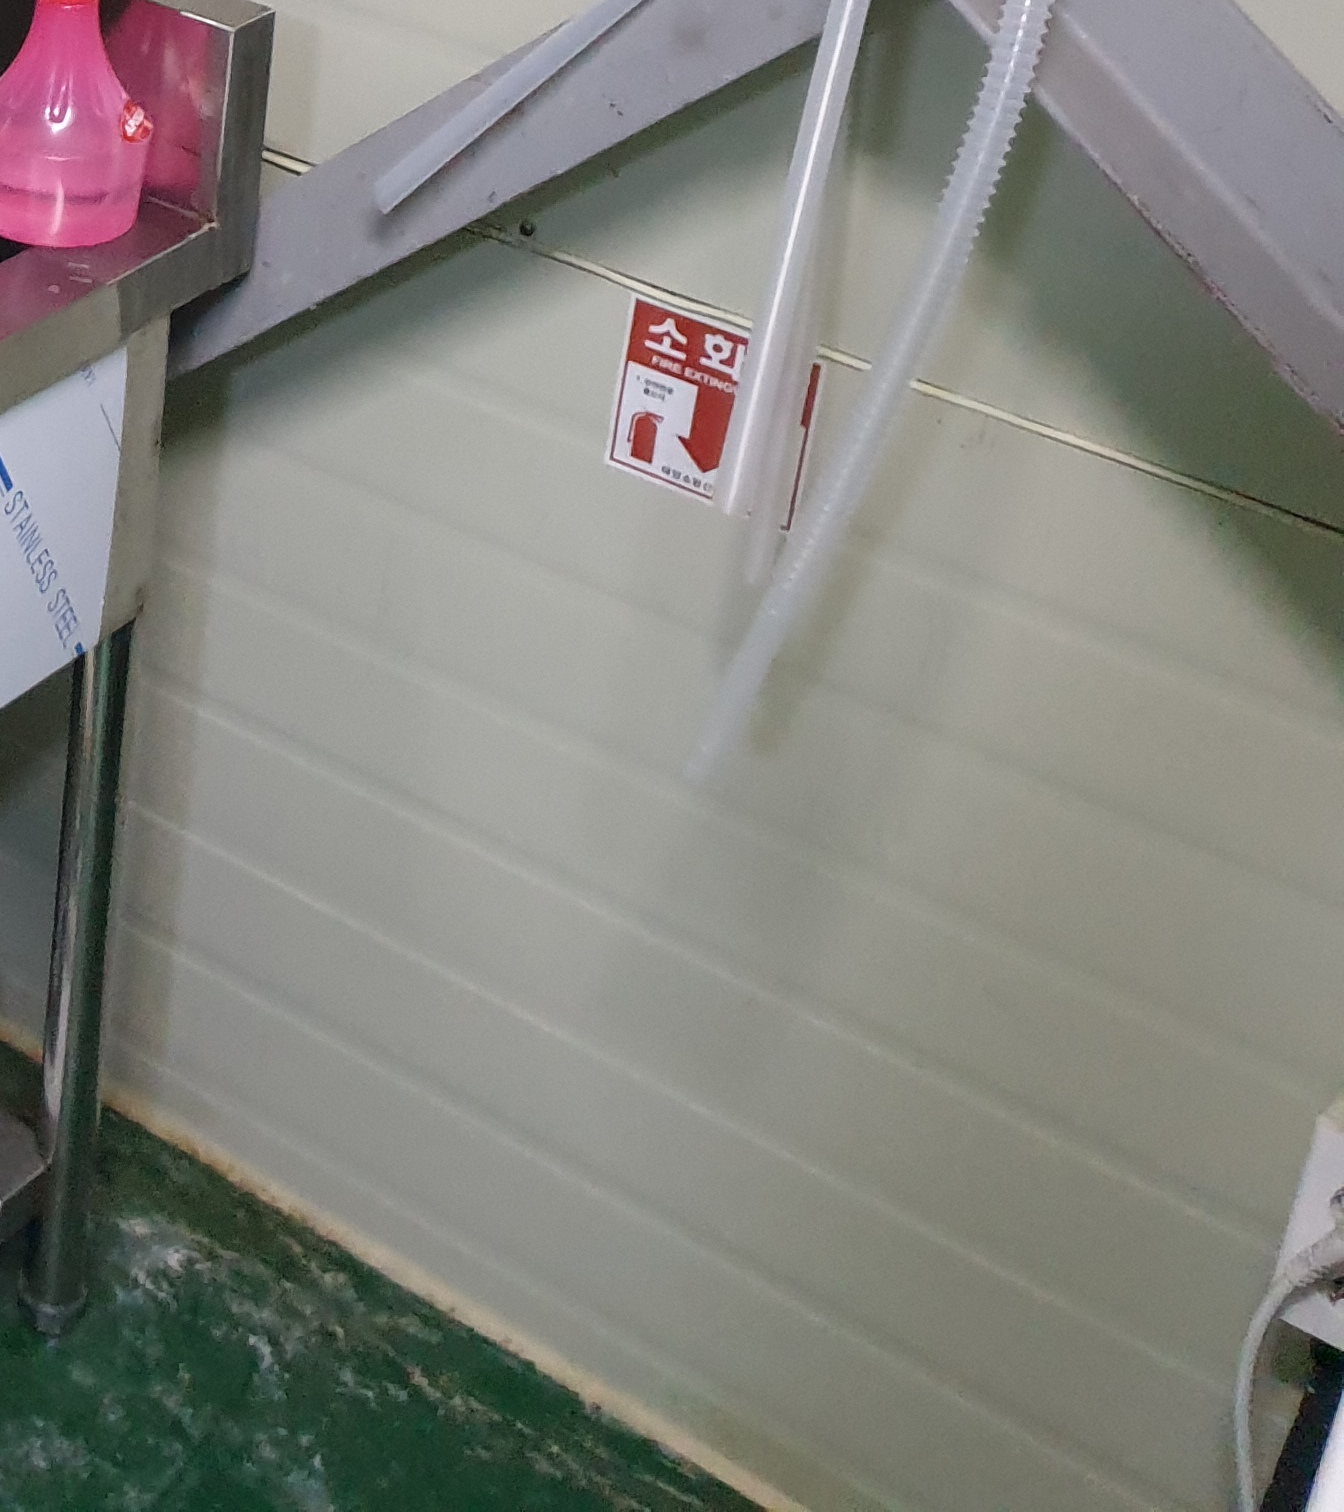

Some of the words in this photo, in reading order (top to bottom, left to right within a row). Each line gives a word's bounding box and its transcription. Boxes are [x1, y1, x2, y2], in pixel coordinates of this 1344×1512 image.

[643, 317, 746, 382] 소화
[4, 490, 58, 594] STAINLESS
[47, 588, 79, 651] STEEL
